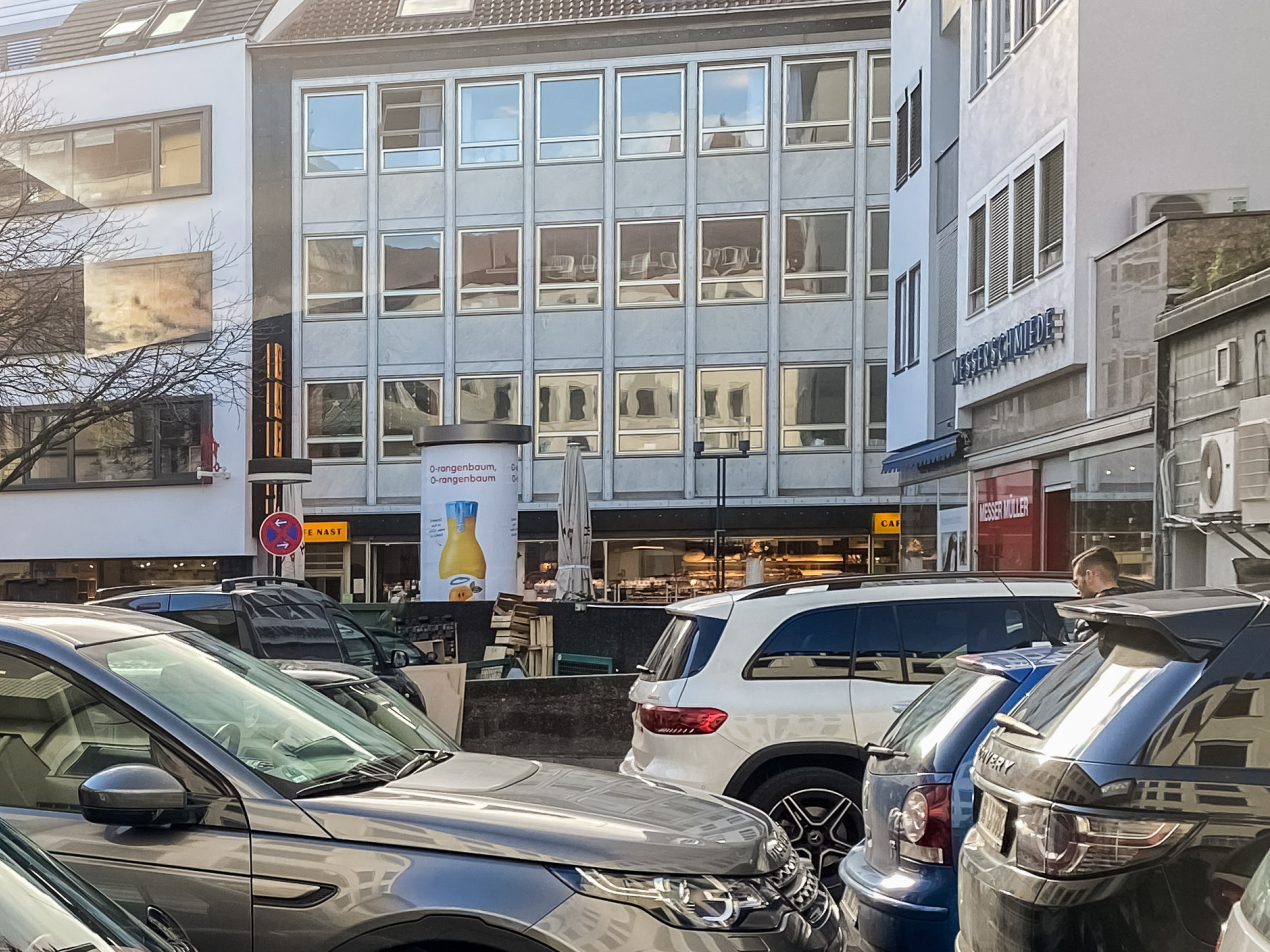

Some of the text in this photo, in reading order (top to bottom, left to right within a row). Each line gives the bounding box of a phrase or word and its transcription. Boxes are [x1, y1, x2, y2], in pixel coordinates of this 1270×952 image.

[952, 307, 1064, 385] MESSERSCHMIEDE
[430, 474, 496, 485] O-rangenbaum
[979, 500, 1003, 522] MESSER
[1003, 493, 1029, 519] MÜLLER
[316, 528, 342, 536] NAST
